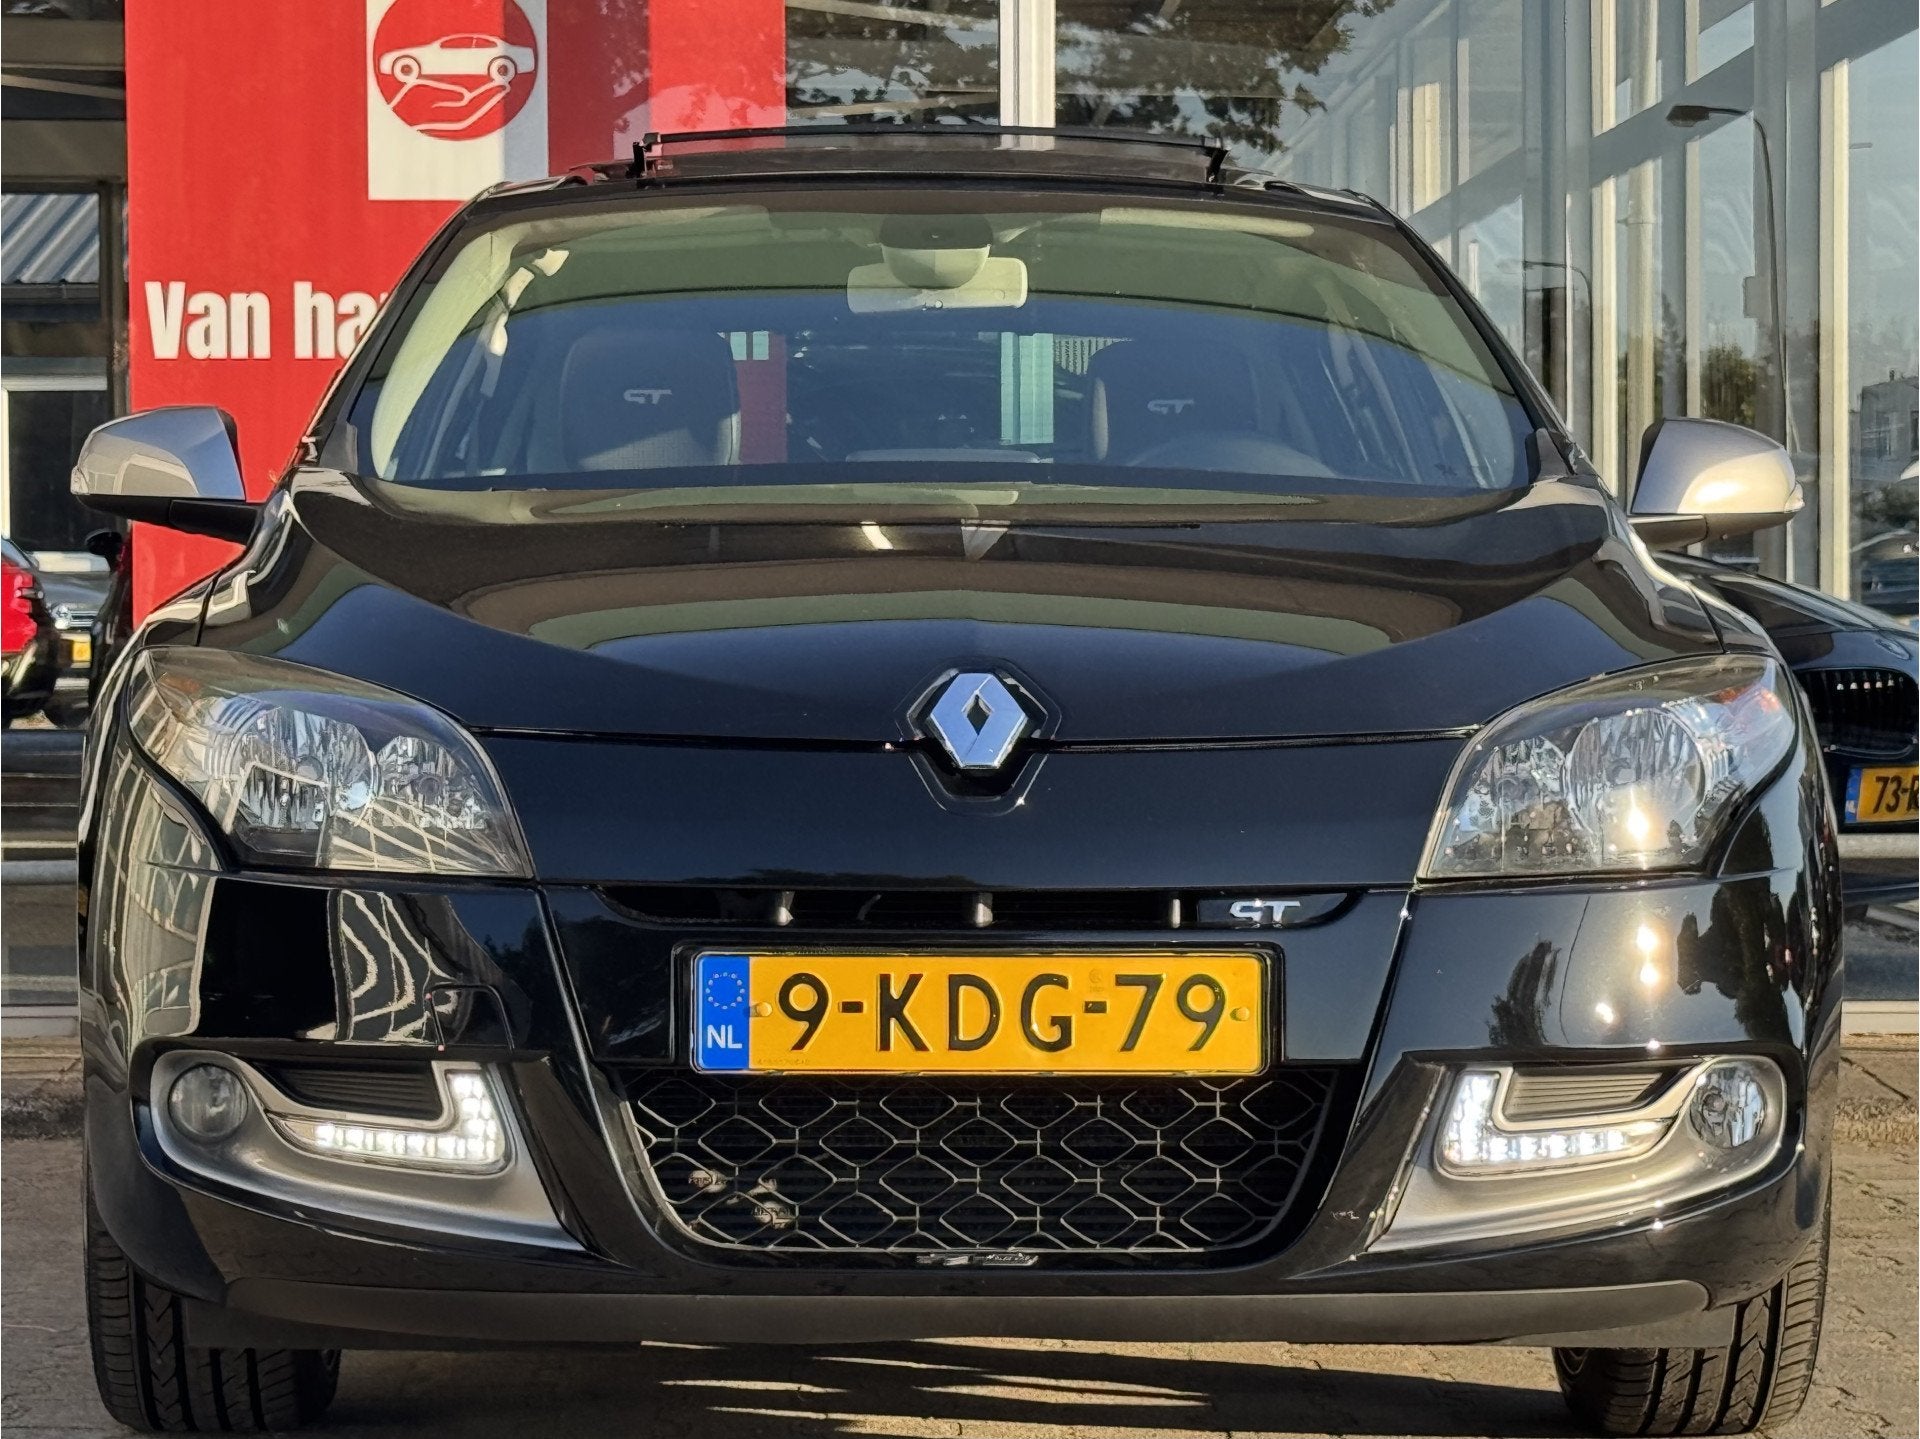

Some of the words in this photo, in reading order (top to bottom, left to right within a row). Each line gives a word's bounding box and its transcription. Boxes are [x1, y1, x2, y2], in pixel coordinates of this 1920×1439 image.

[145, 281, 270, 359] Van
[294, 281, 388, 359] ha
[623, 389, 672, 404] GT
[1147, 399, 1195, 414] GT
[1229, 900, 1301, 922] GT
[778, 972, 1227, 1052] 9-KDG-79
[706, 1024, 743, 1049] NL
